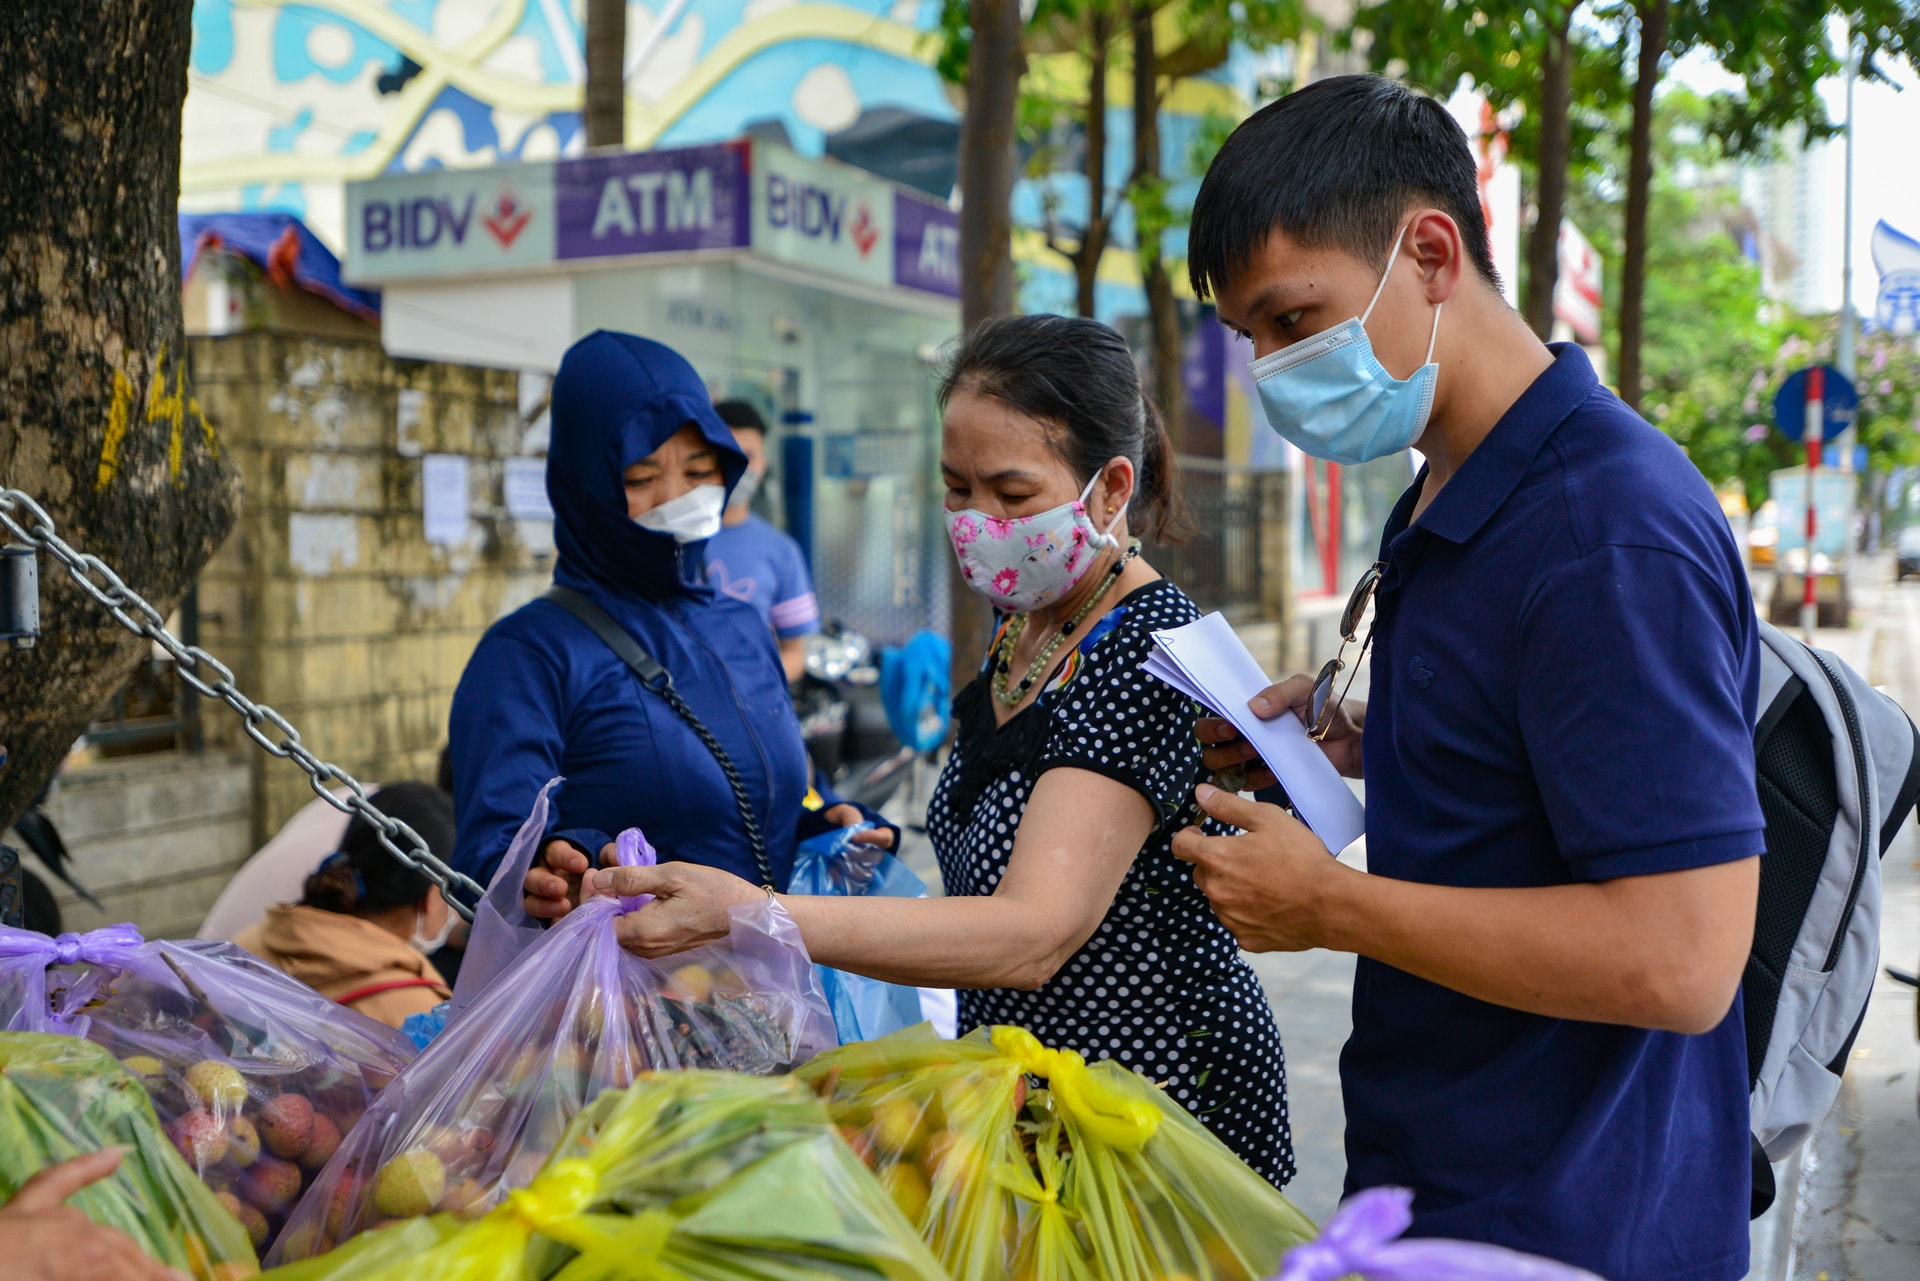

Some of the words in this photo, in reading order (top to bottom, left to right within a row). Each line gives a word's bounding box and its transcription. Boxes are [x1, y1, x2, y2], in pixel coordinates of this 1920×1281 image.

[362, 193, 475, 254] BIDV
[592, 168, 714, 238] ATM
[767, 170, 847, 245] BIDV
[917, 221, 961, 281] AT
